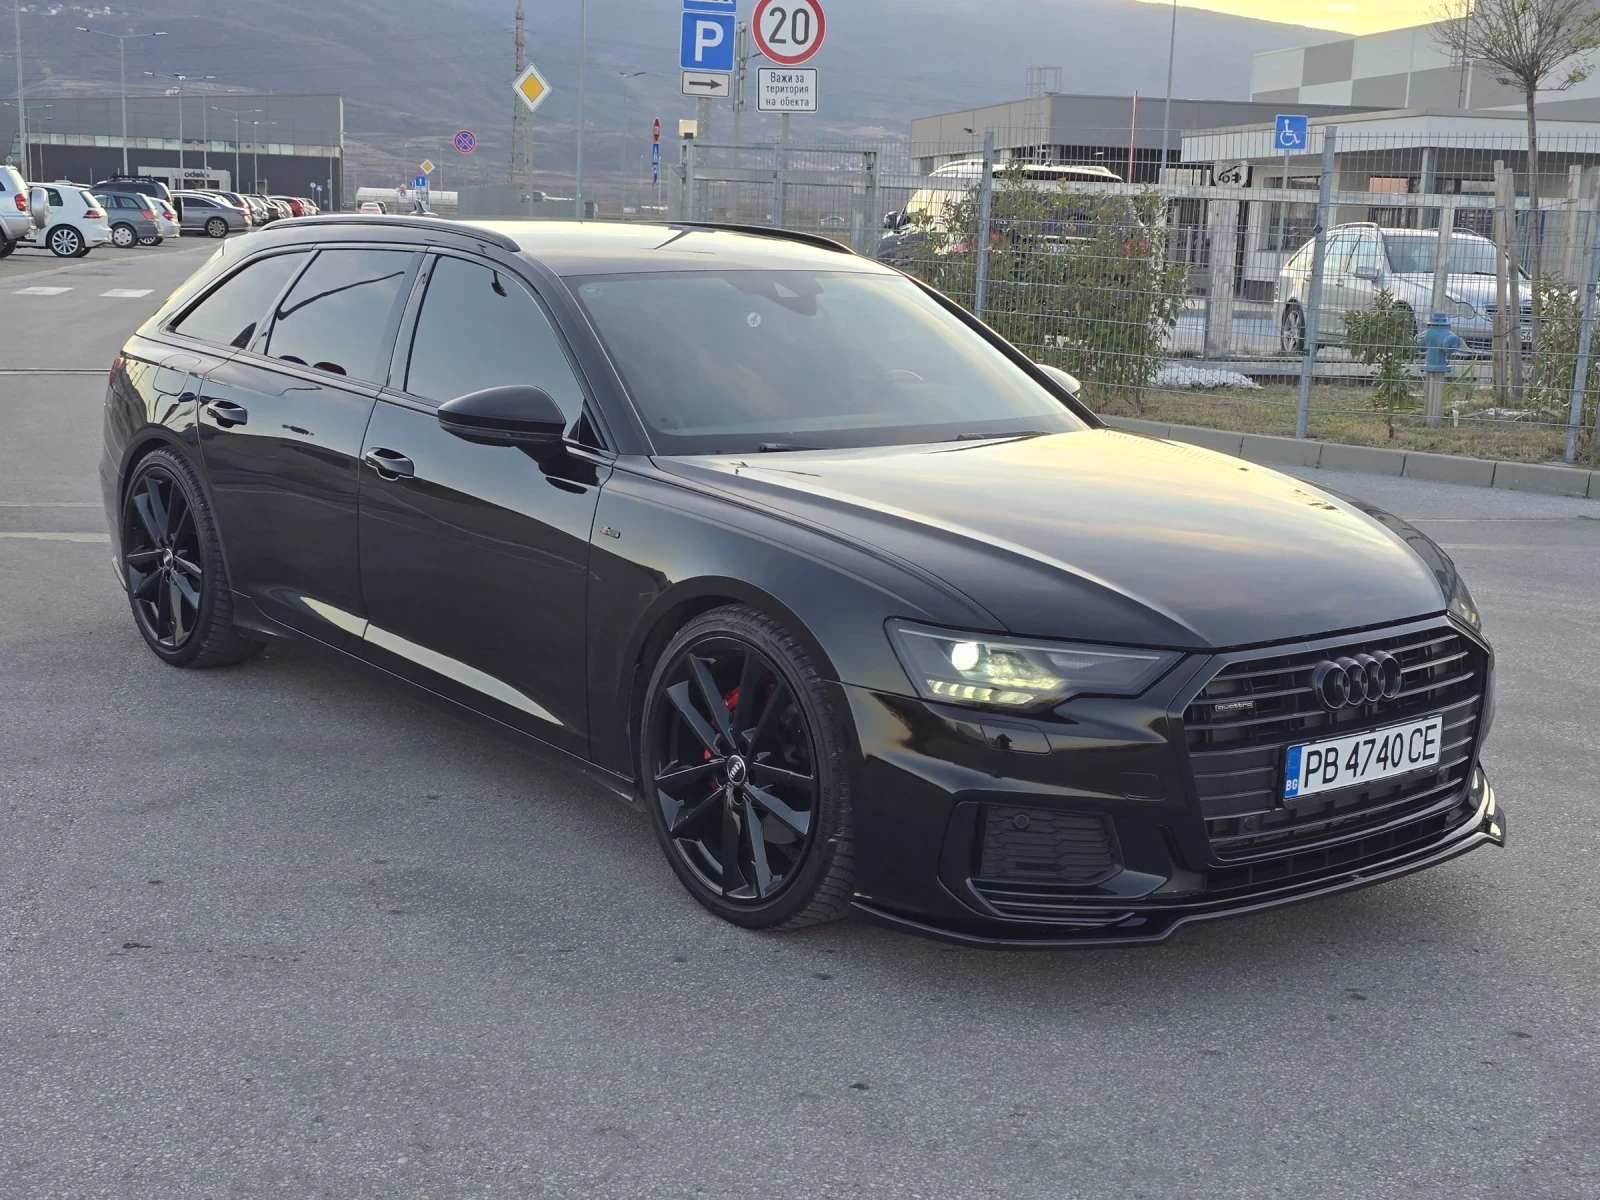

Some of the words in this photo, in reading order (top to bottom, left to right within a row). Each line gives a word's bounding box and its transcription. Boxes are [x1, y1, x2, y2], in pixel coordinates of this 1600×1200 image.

[768, 6, 810, 46] 20
[694, 20, 724, 62] P
[770, 72, 793, 83] Важи
[795, 74, 805, 83] за
[766, 85, 809, 95] територия
[780, 97, 809, 107] обекта
[1216, 701, 1253, 711] quattro
[1304, 747, 1339, 788] PB
[1345, 732, 1404, 778] 4740
[1408, 723, 1438, 763] CE
[1285, 778, 1298, 791] BG
